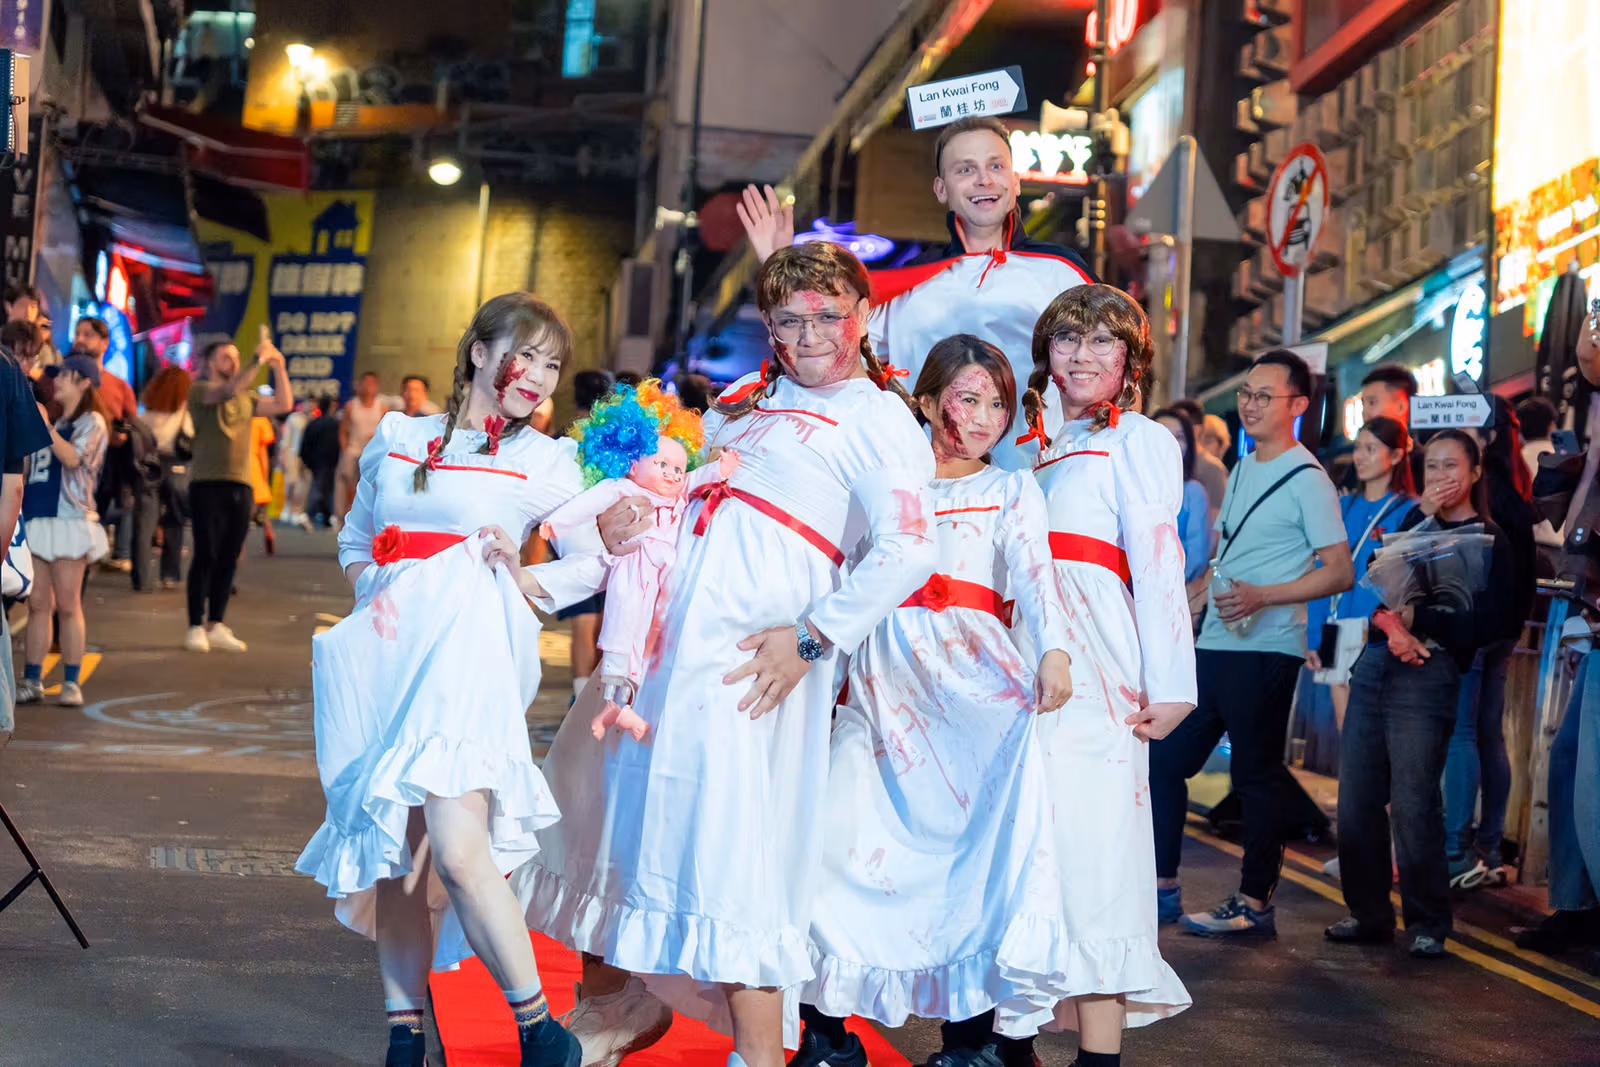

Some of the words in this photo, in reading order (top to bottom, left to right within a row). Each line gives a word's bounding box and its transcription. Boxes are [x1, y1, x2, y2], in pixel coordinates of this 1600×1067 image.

[919, 91, 940, 102] Lan
[942, 84, 969, 98] Kwai
[971, 80, 999, 92] Fong
[940, 99, 985, 118] 蘭桂坊
[276, 311, 308, 332] DO
[1417, 401, 1432, 409] Lan
[1434, 400, 1454, 408] Kwai
[1456, 400, 1476, 408] Fong
